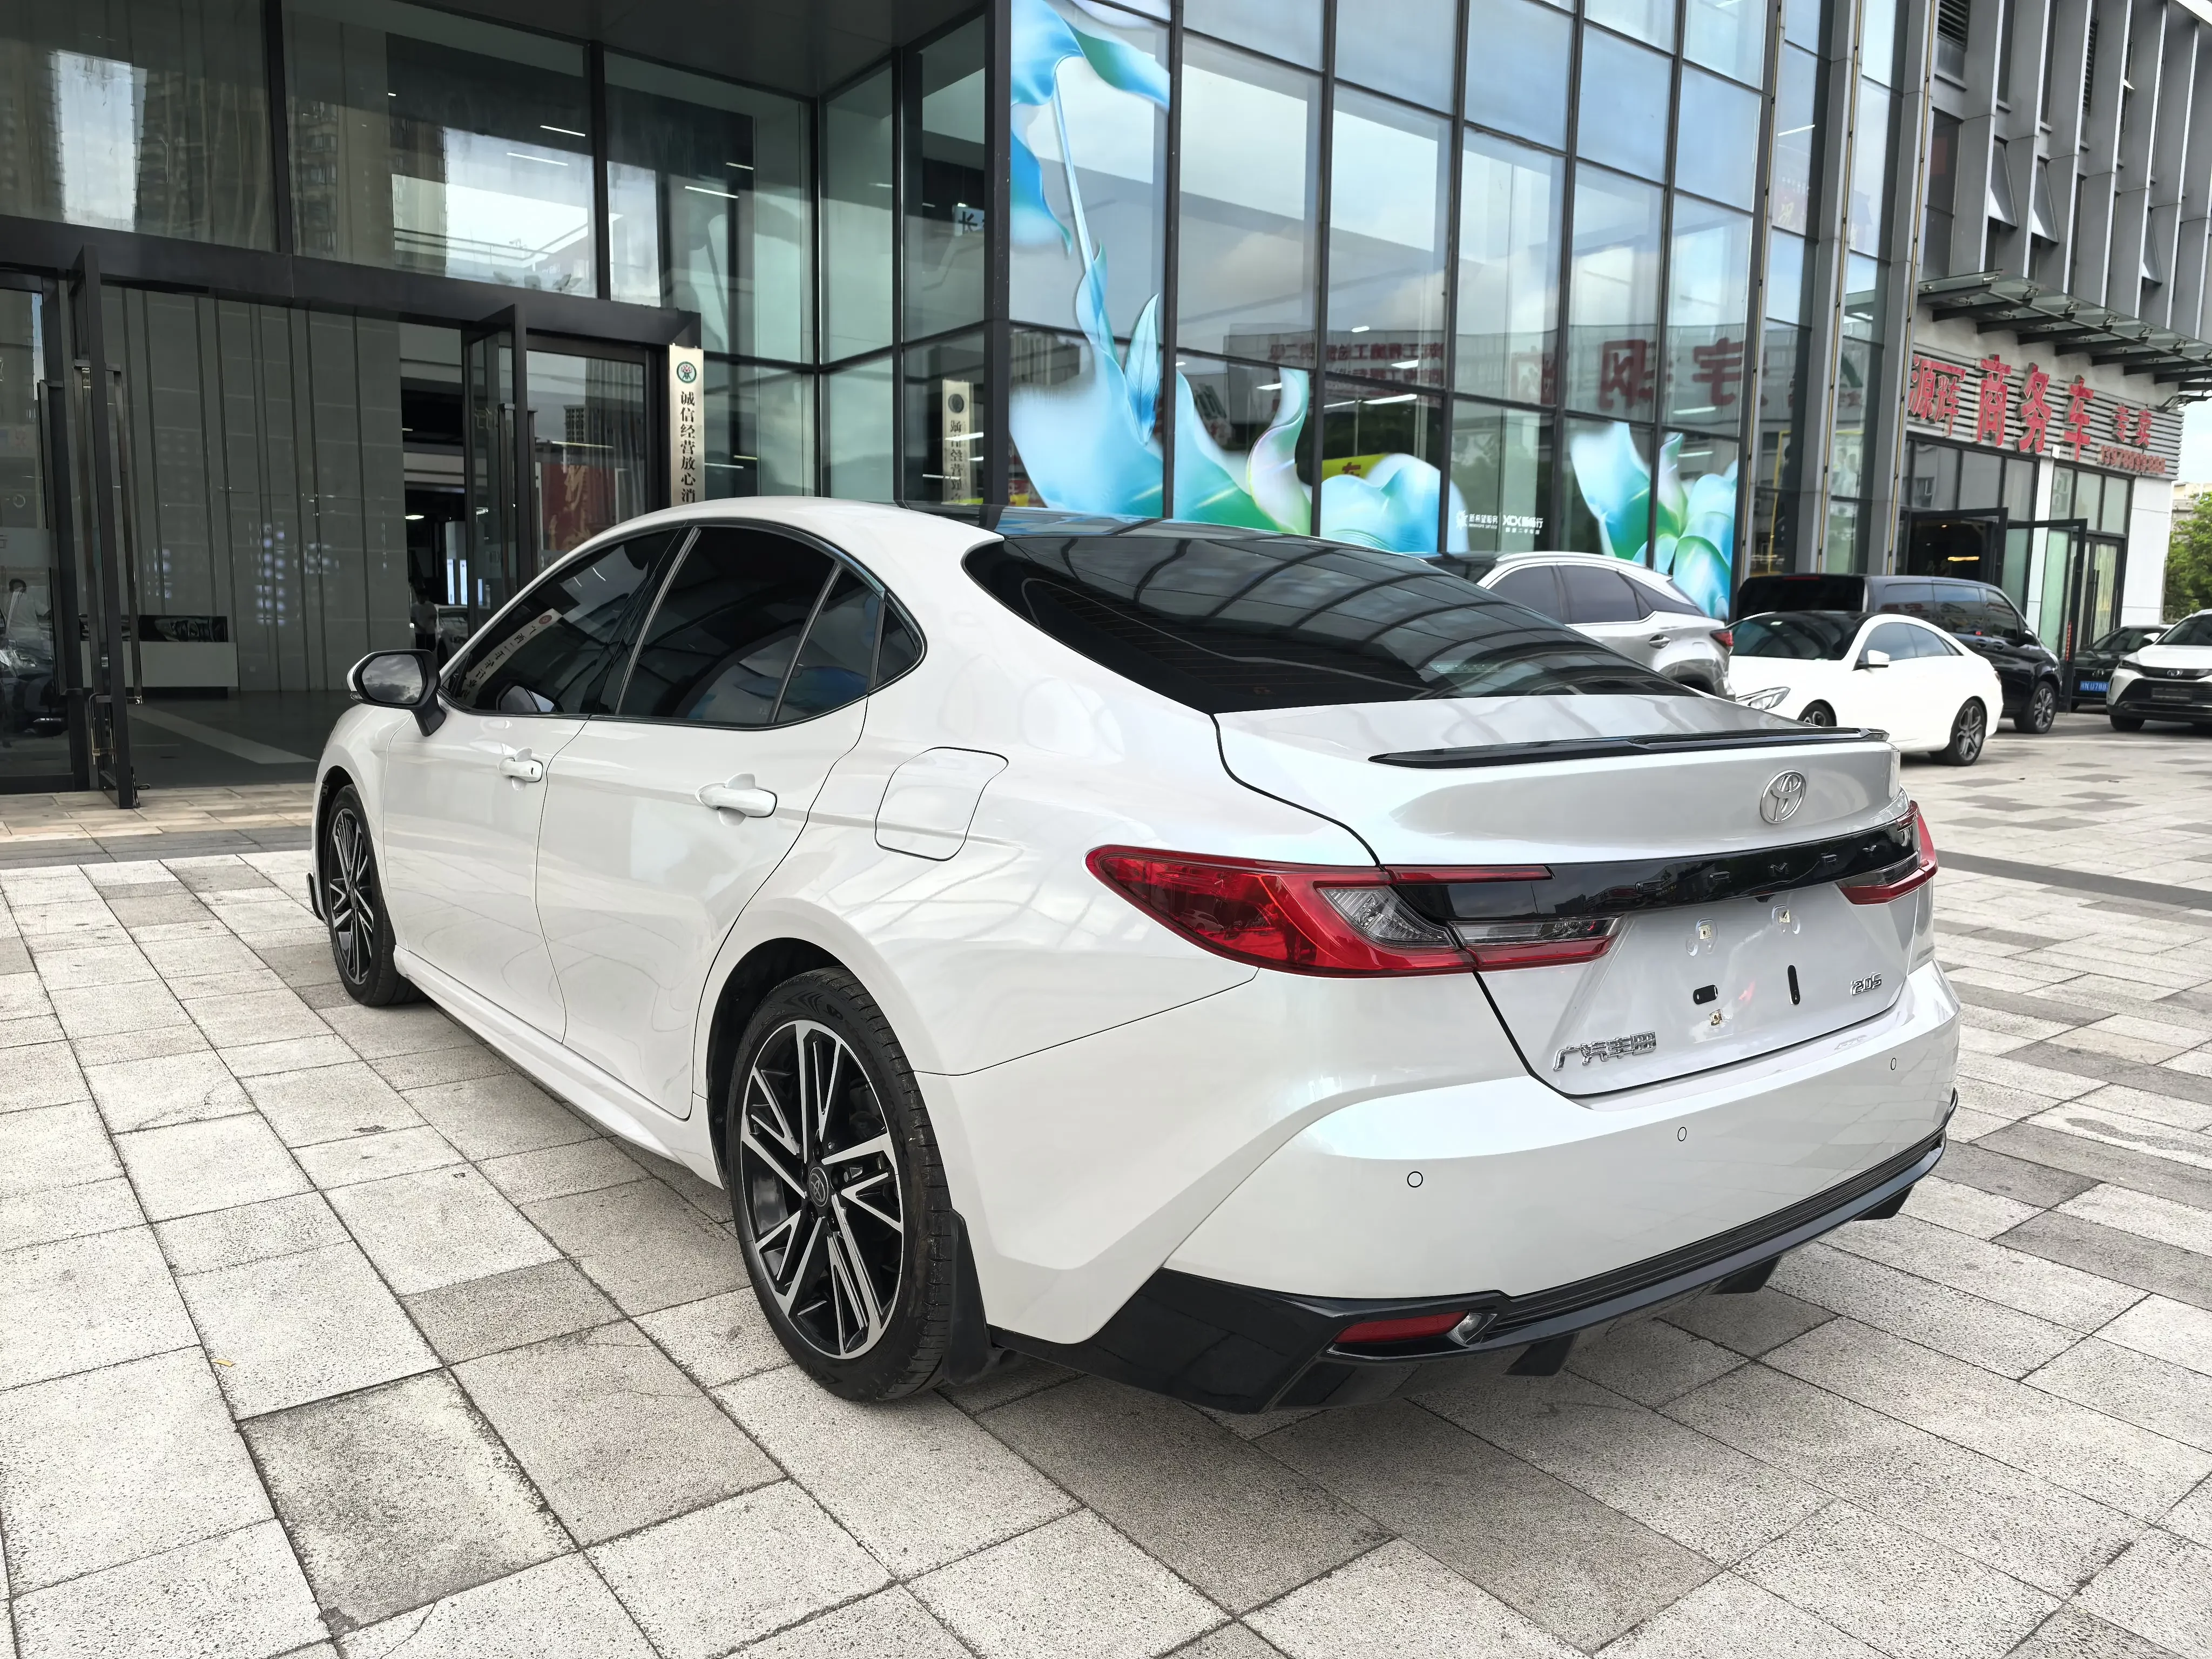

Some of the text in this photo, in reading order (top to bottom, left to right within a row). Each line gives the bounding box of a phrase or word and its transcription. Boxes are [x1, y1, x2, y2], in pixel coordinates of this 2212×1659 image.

[680, 390, 696, 503] 诚信经营放心消
